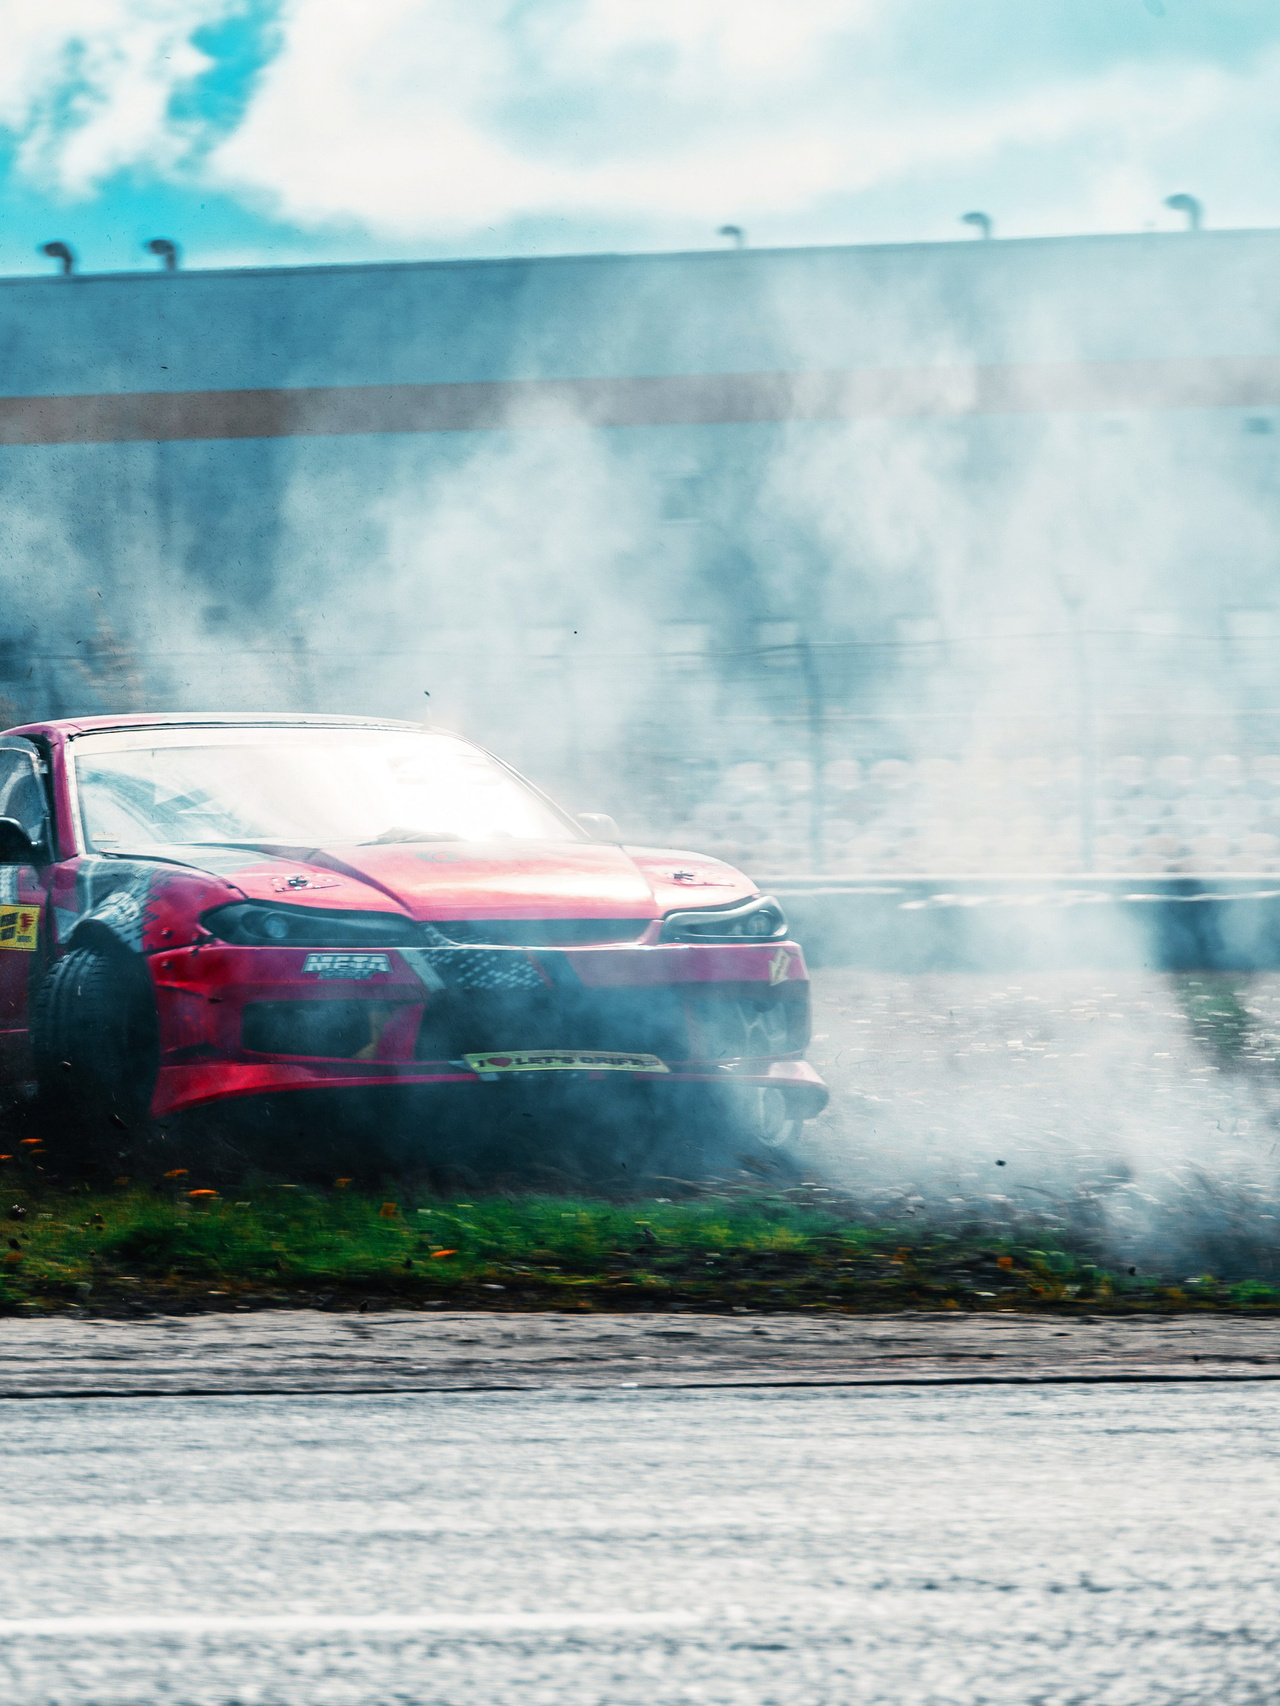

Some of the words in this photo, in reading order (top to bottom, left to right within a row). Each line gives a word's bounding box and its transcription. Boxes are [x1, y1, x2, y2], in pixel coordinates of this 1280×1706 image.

[303, 956, 390, 972] META
[477, 1059, 485, 1067] I
[514, 1056, 575, 1065] LET'S
[579, 1057, 641, 1066] DRIFT
